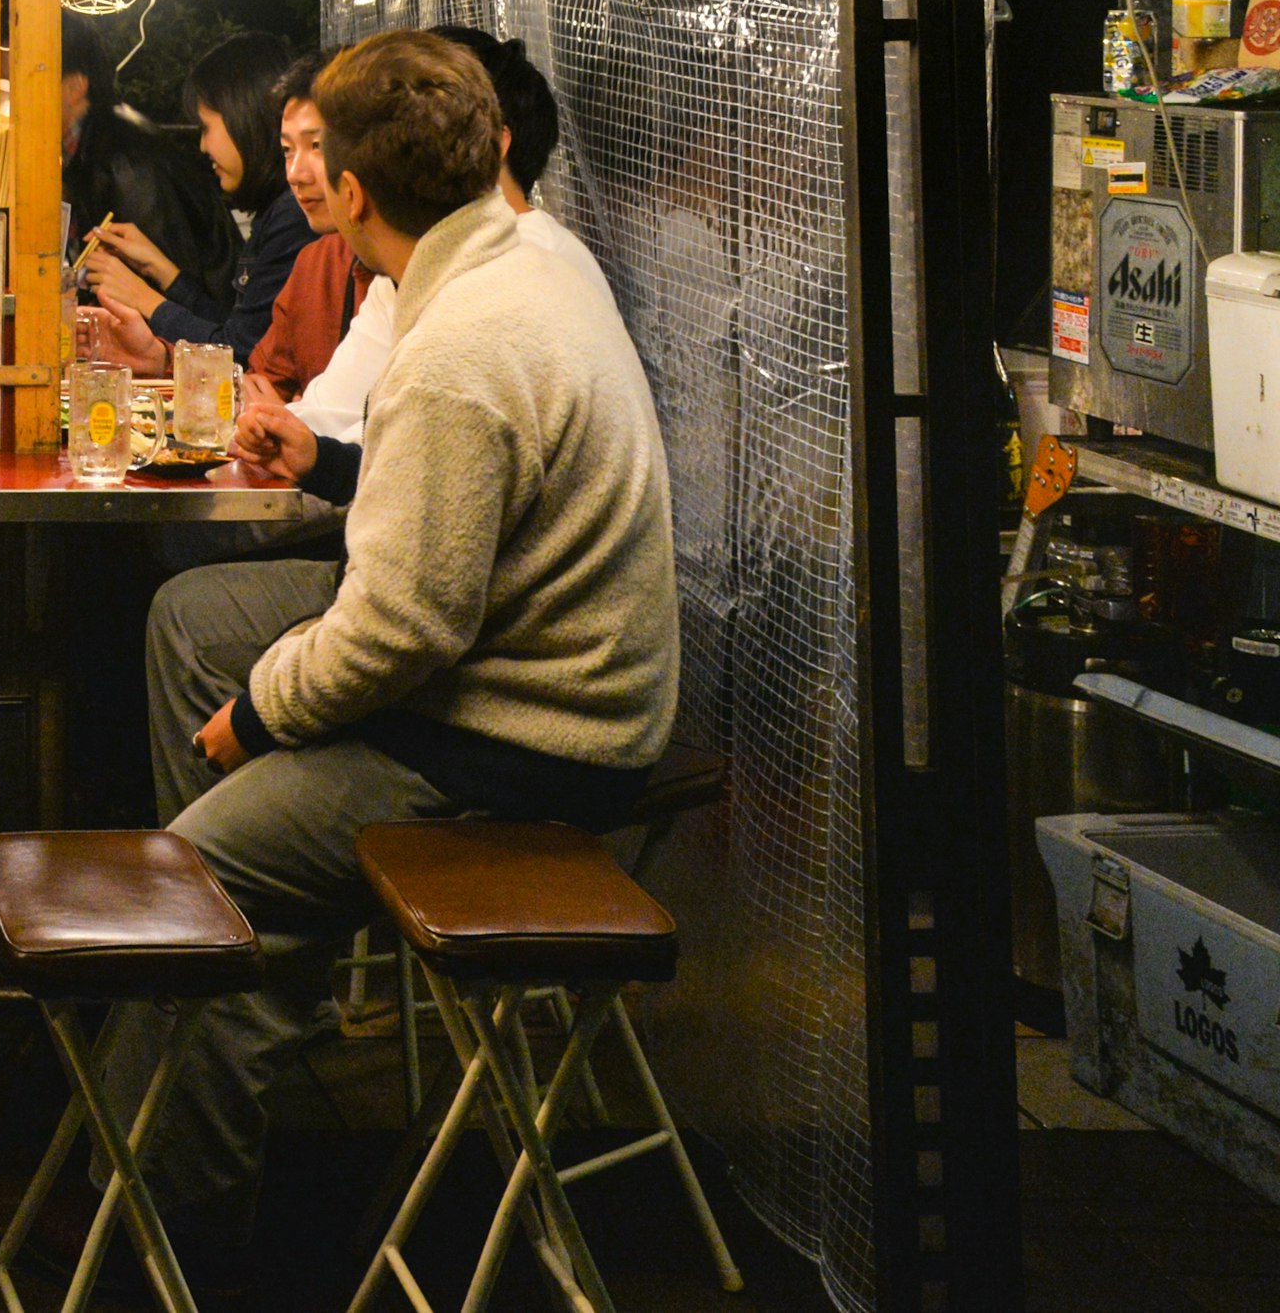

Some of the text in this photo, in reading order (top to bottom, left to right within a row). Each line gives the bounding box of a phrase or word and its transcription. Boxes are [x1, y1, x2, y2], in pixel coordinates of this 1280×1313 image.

[1108, 252, 1182, 308] Asahi
[1135, 323, 1152, 344] 生
[1175, 1000, 1239, 1064] LOGOS
